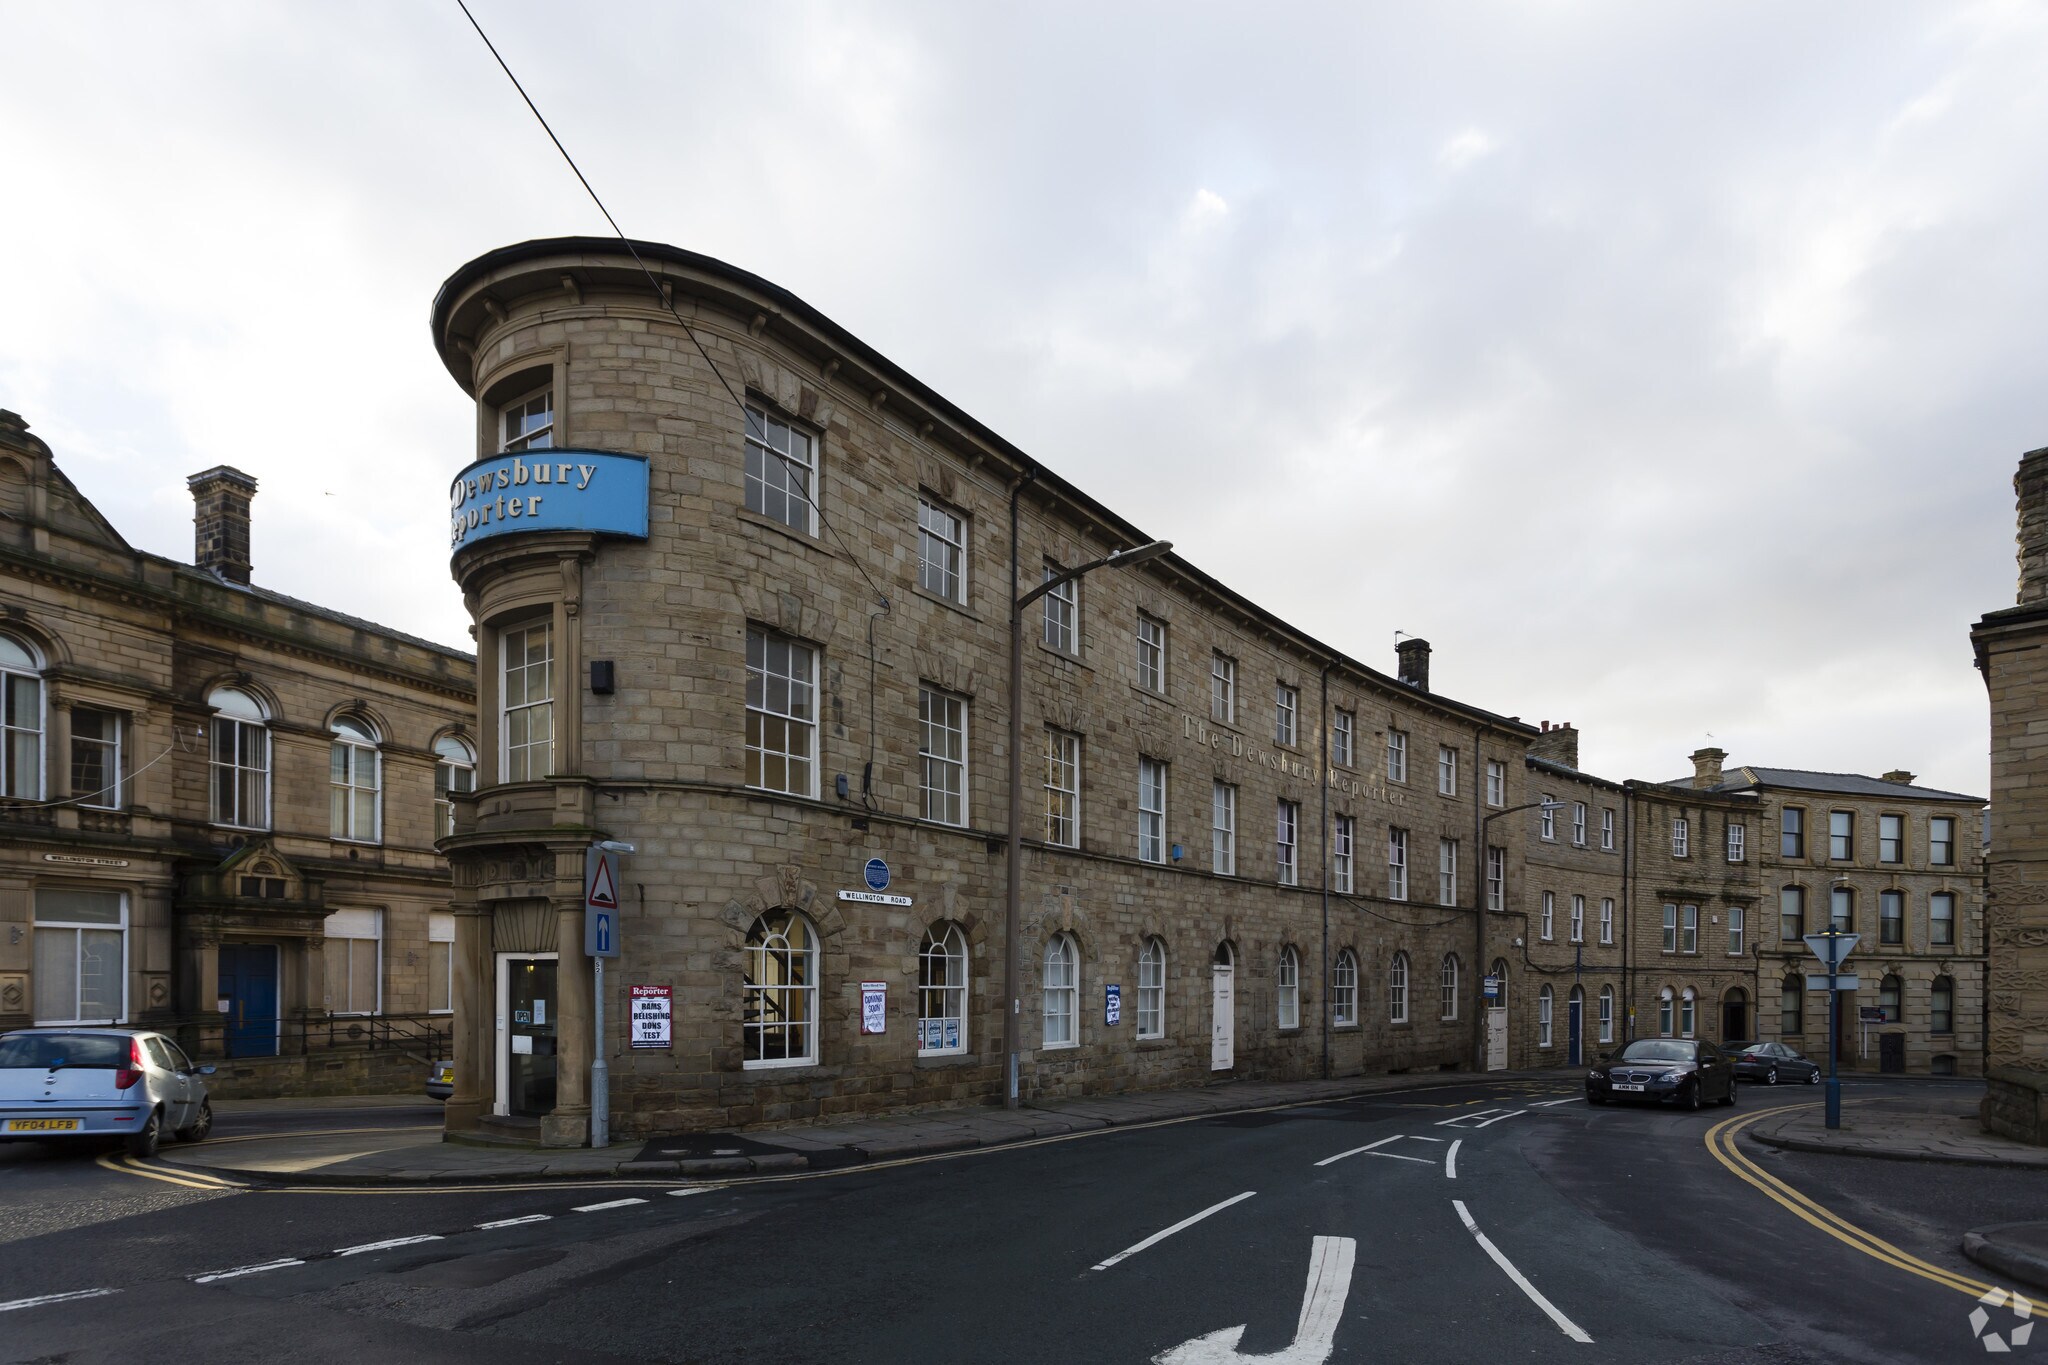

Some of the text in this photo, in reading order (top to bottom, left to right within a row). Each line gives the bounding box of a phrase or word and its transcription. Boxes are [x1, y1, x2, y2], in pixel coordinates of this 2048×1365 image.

[453, 458, 597, 510] Dewsbury
[451, 494, 543, 542] eporter
[1181, 713, 1405, 806] The Dewsbury Reporter
[846, 892, 907, 904] WELLINGTON ROAD
[632, 987, 669, 996] Reporter
[864, 994, 883, 1004] COMING
[517, 1011, 529, 1021] OPEN
[641, 1022, 662, 1030] DONS
[643, 1031, 661, 1039] TEST
[15, 1120, 73, 1130] YF04 LFB
